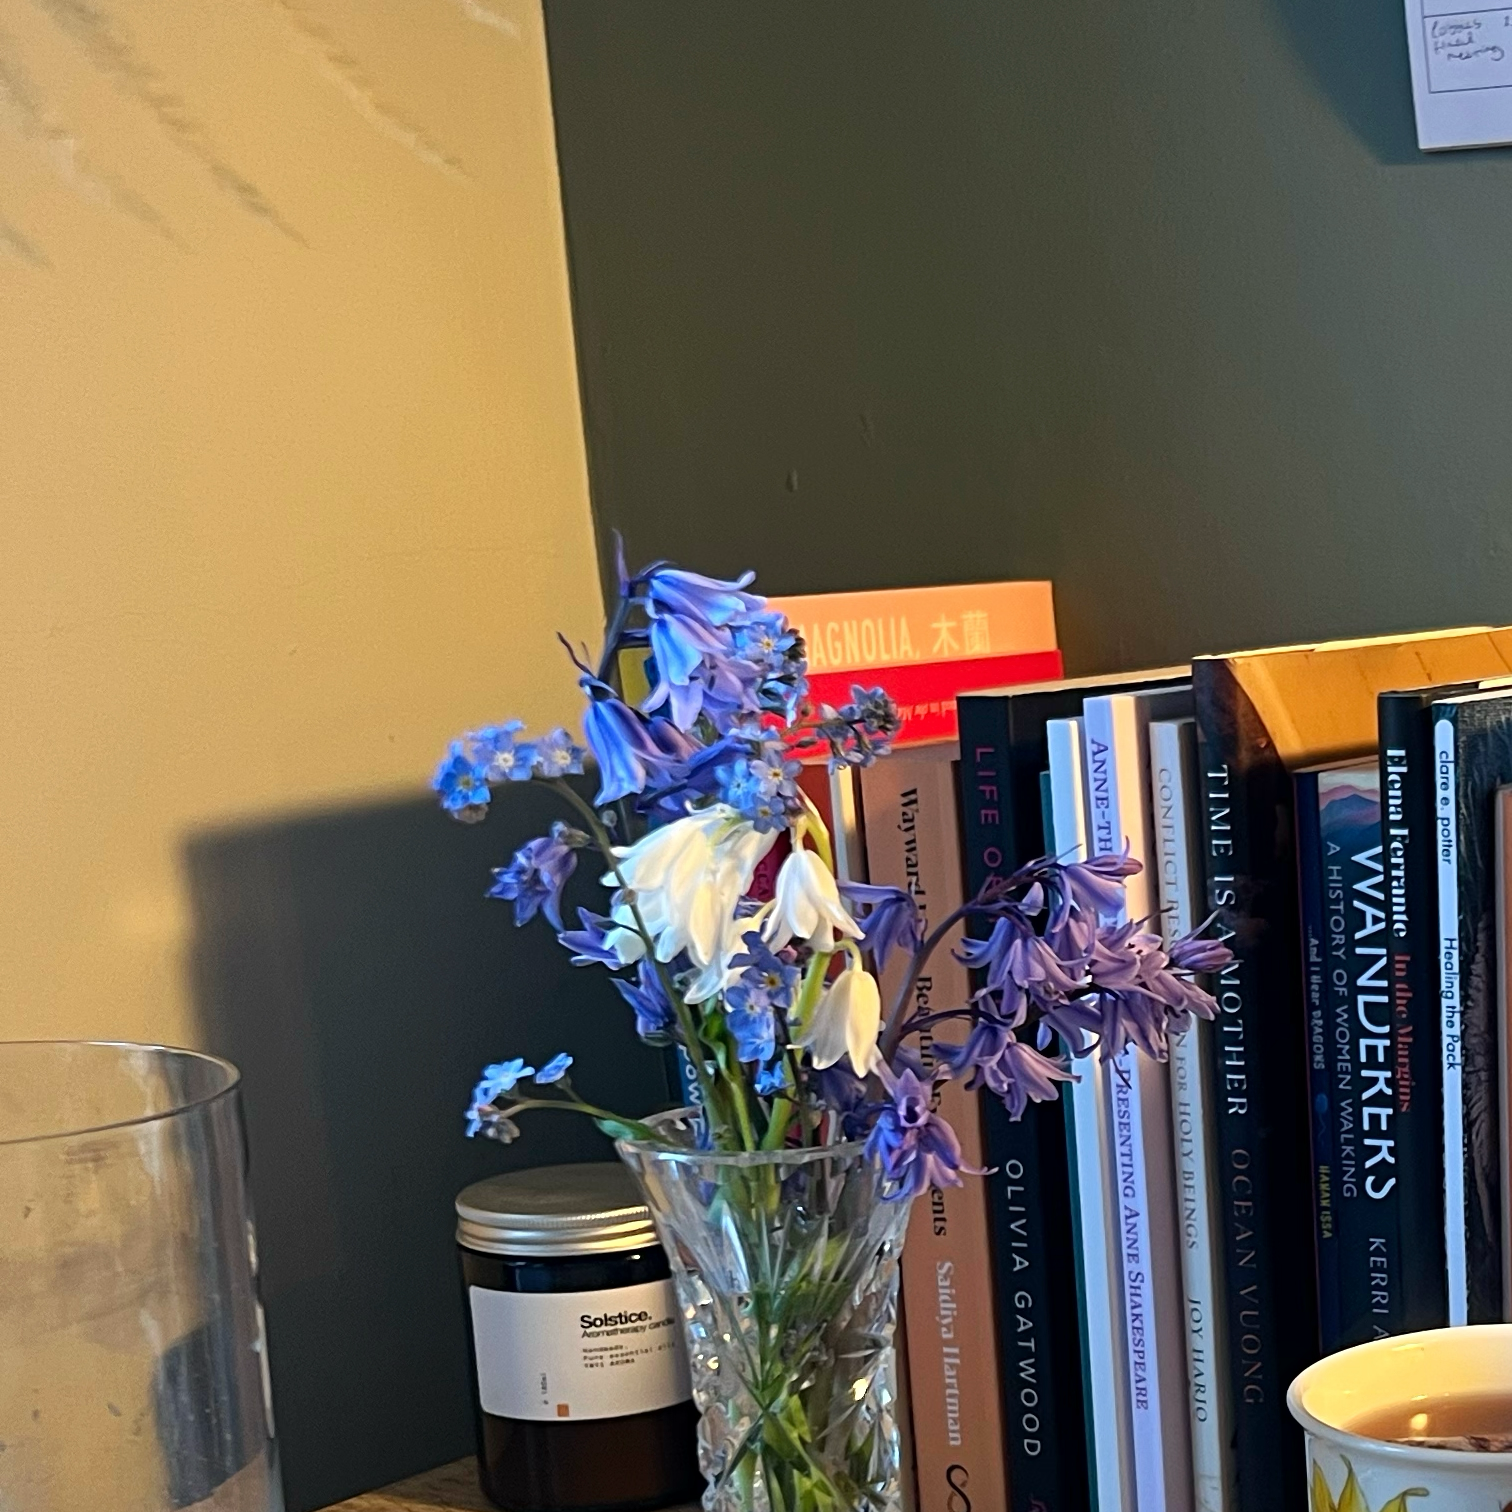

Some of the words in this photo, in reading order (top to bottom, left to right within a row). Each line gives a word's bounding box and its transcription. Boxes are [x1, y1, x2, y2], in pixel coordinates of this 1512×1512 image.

[975, 747, 1000, 825] LIFE
[1091, 738, 1114, 853] ANNE-TH
[1387, 749, 1408, 821] Elena
[1438, 750, 1454, 791] clare
[1440, 797, 1450, 810] e.
[1158, 768, 1178, 892] CONFLICT
[1207, 764, 1233, 857] TIME
[1326, 841, 1341, 856] A
[1436, 817, 1453, 865] potter
[1213, 876, 1235, 905] IS
[1327, 866, 1347, 960] HISTORY
[1389, 828, 1410, 937] Ferrante
[1216, 923, 1236, 941] A
[1394, 955, 1410, 976] In
[1440, 937, 1460, 999] Healing
[1332, 969, 1348, 997] OF
[1395, 983, 1413, 1018] the
[1445, 1005, 1461, 1027] the
[1220, 960, 1249, 1115] MOTHER
[1335, 1005, 1352, 1090] WOMEN
[1350, 844, 1396, 1199] WANDERERS
[1446, 1034, 1461, 1071] Pack
[1175, 1057, 1188, 1091] FOR
[1395, 1025, 1414, 1112] Margins
[1116, 1057, 1136, 1198] -PRESENTING
[1177, 1101, 1193, 1165] HOLY
[1339, 1099, 1357, 1198] WALKING
[1006, 1159, 1029, 1272] OLIVIA
[1124, 1204, 1140, 1264] ANNE
[1181, 1169, 1198, 1250] BEINGS
[1231, 1148, 1257, 1270] OCEAN
[936, 1261, 957, 1339] Saidiya
[1368, 1238, 1390, 1314] KERRI
[580, 1309, 653, 1329] Solstice.
[581, 1324, 647, 1339] Aromatherapy
[1128, 1270, 1148, 1410] SHAKESPEARE
[1188, 1298, 1203, 1340] JOY
[1239, 1284, 1264, 1404] VUONG
[943, 1346, 962, 1446] Hartman
[1015, 1290, 1041, 1456] GATWOOD
[1189, 1349, 1208, 1423] HARJO
